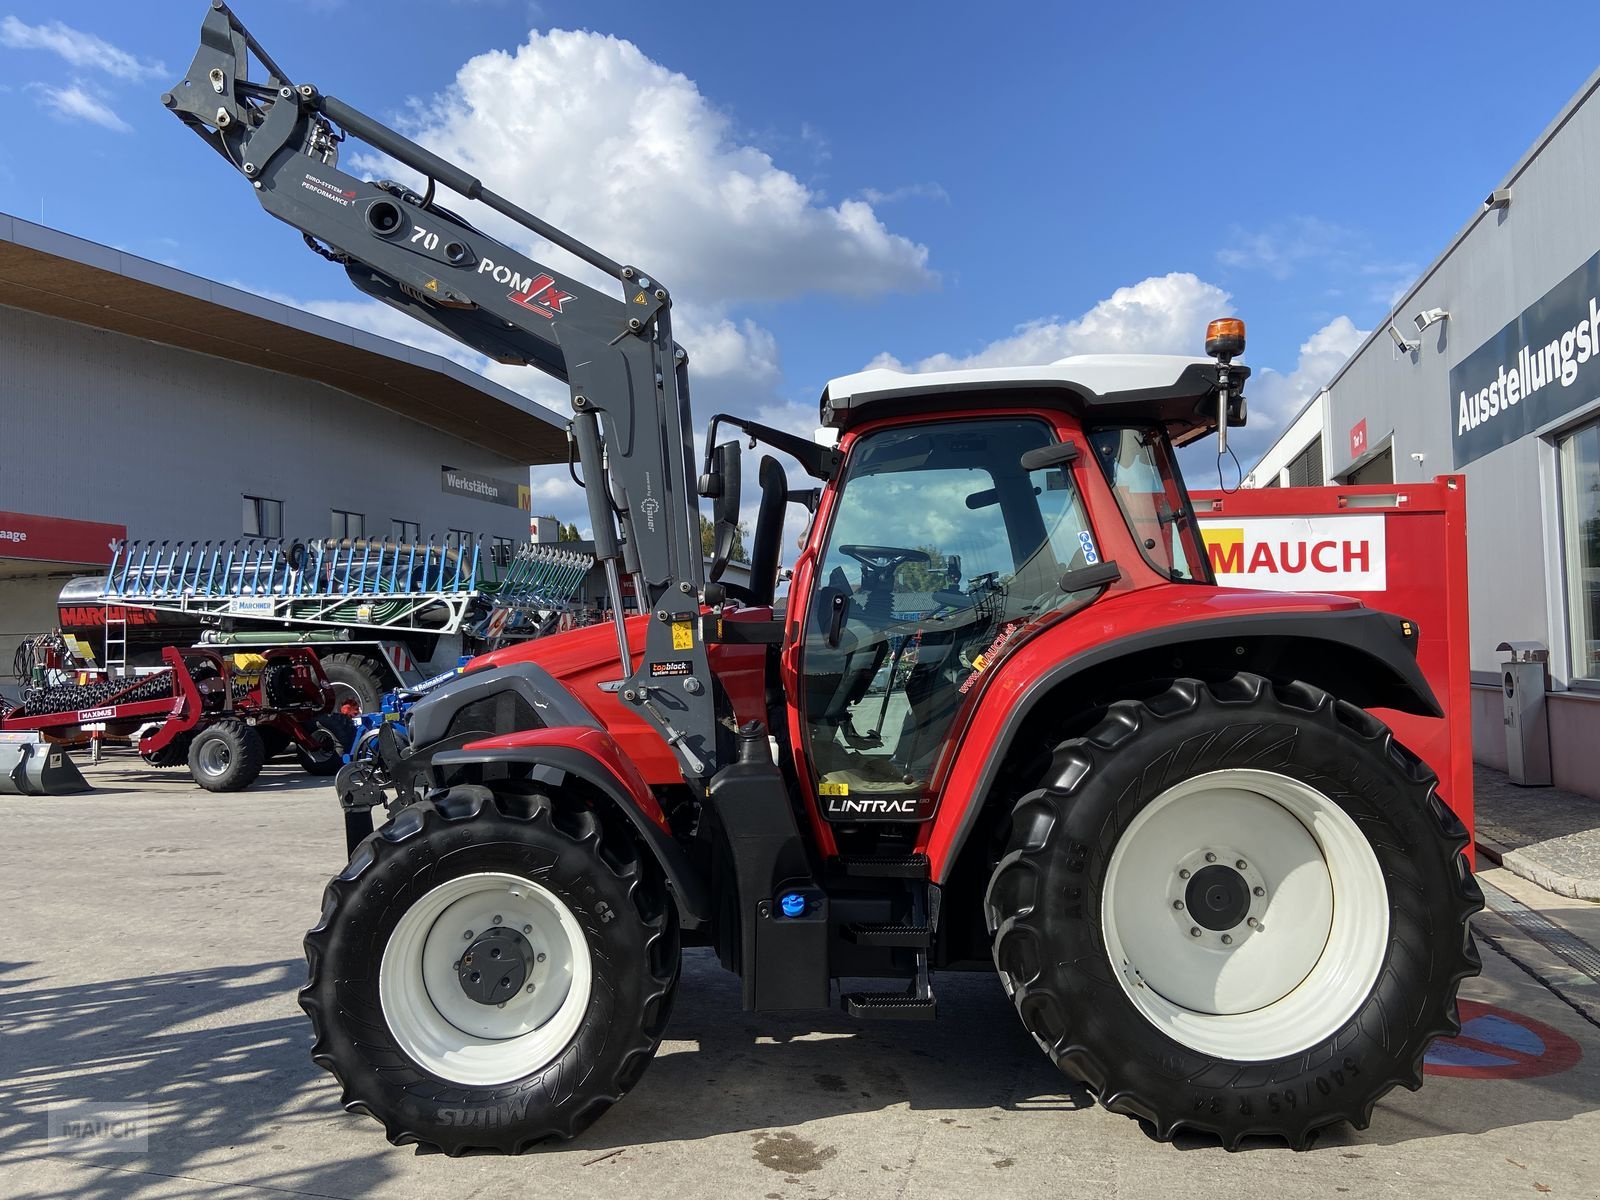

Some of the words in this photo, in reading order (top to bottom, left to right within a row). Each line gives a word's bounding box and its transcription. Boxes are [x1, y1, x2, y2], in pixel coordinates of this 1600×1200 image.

[301, 181, 349, 207] PERFORMANCE
[410, 225, 440, 251] 70
[446, 472, 499, 498] Werkstätten
[1208, 540, 1370, 574] MAUCH
[82, 709, 112, 719] MAXIMUS
[828, 799, 917, 812] LINTRAC
